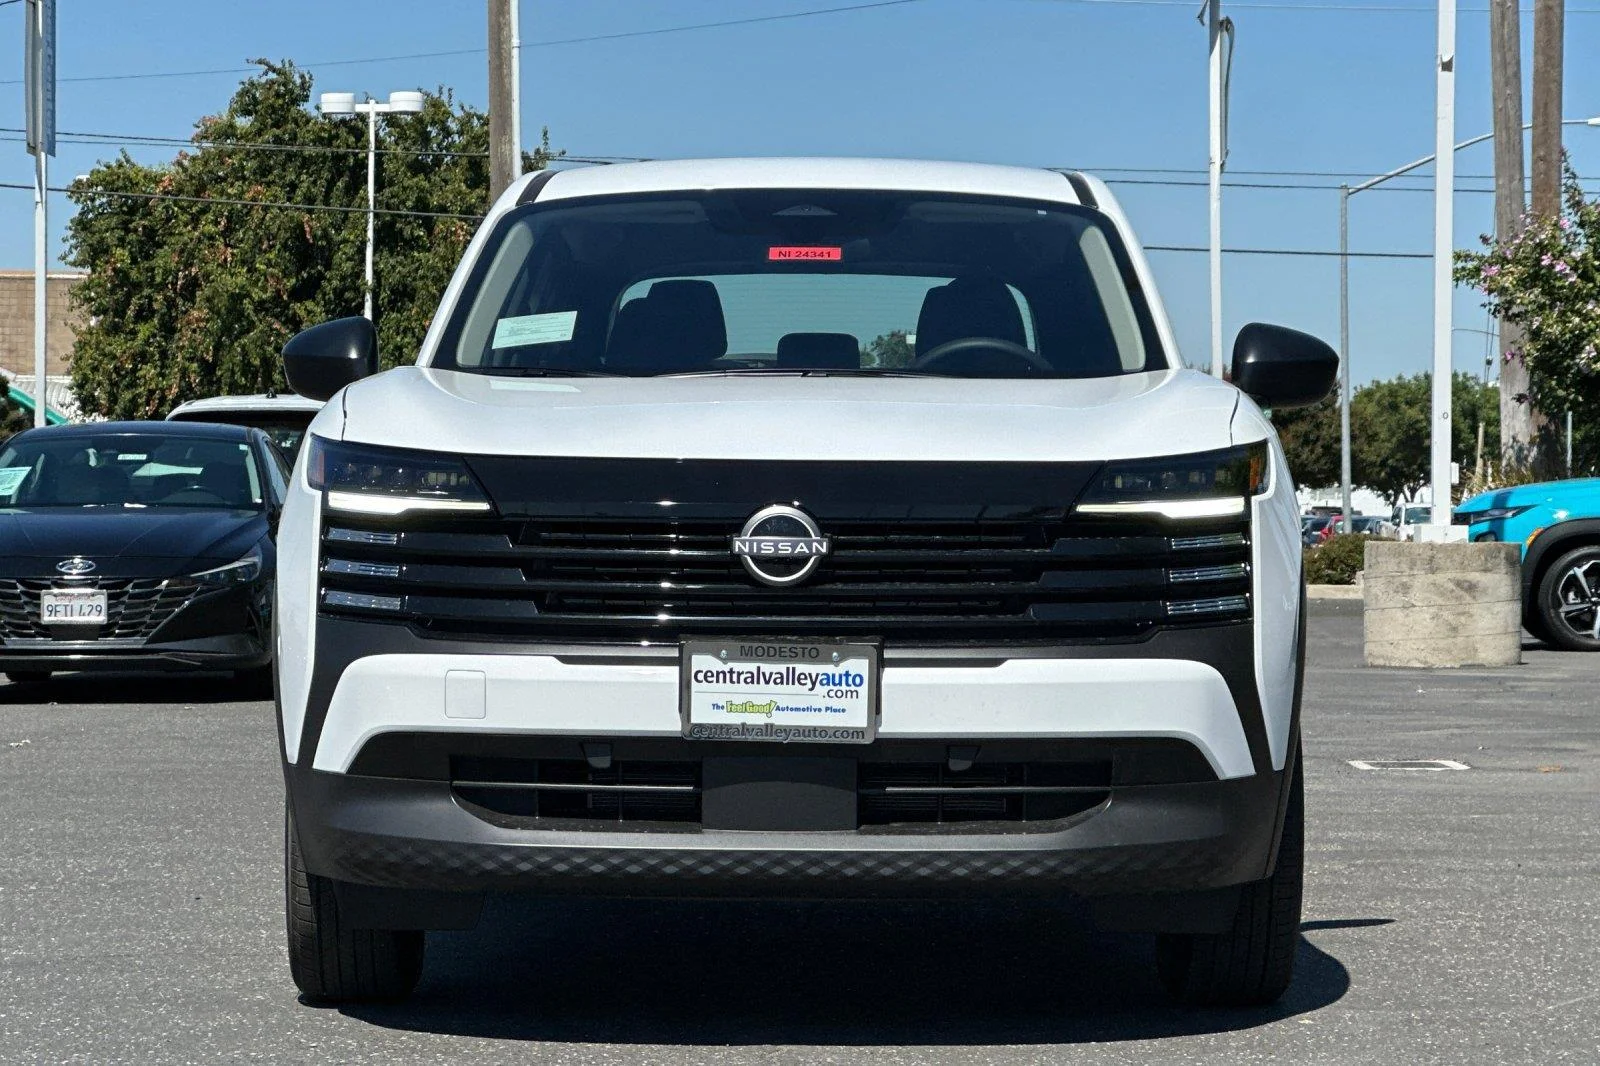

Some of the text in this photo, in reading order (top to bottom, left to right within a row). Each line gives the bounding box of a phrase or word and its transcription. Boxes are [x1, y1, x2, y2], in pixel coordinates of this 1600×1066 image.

[735, 541, 827, 554] NISSAN
[739, 645, 820, 659] MODESTO
[693, 666, 864, 691] centralvalleyauto
[822, 688, 859, 699] .com
[712, 703, 725, 711] The
[775, 705, 823, 713] Automotive
[825, 706, 846, 714] Place
[690, 722, 865, 744] centralvalleyauto.com
